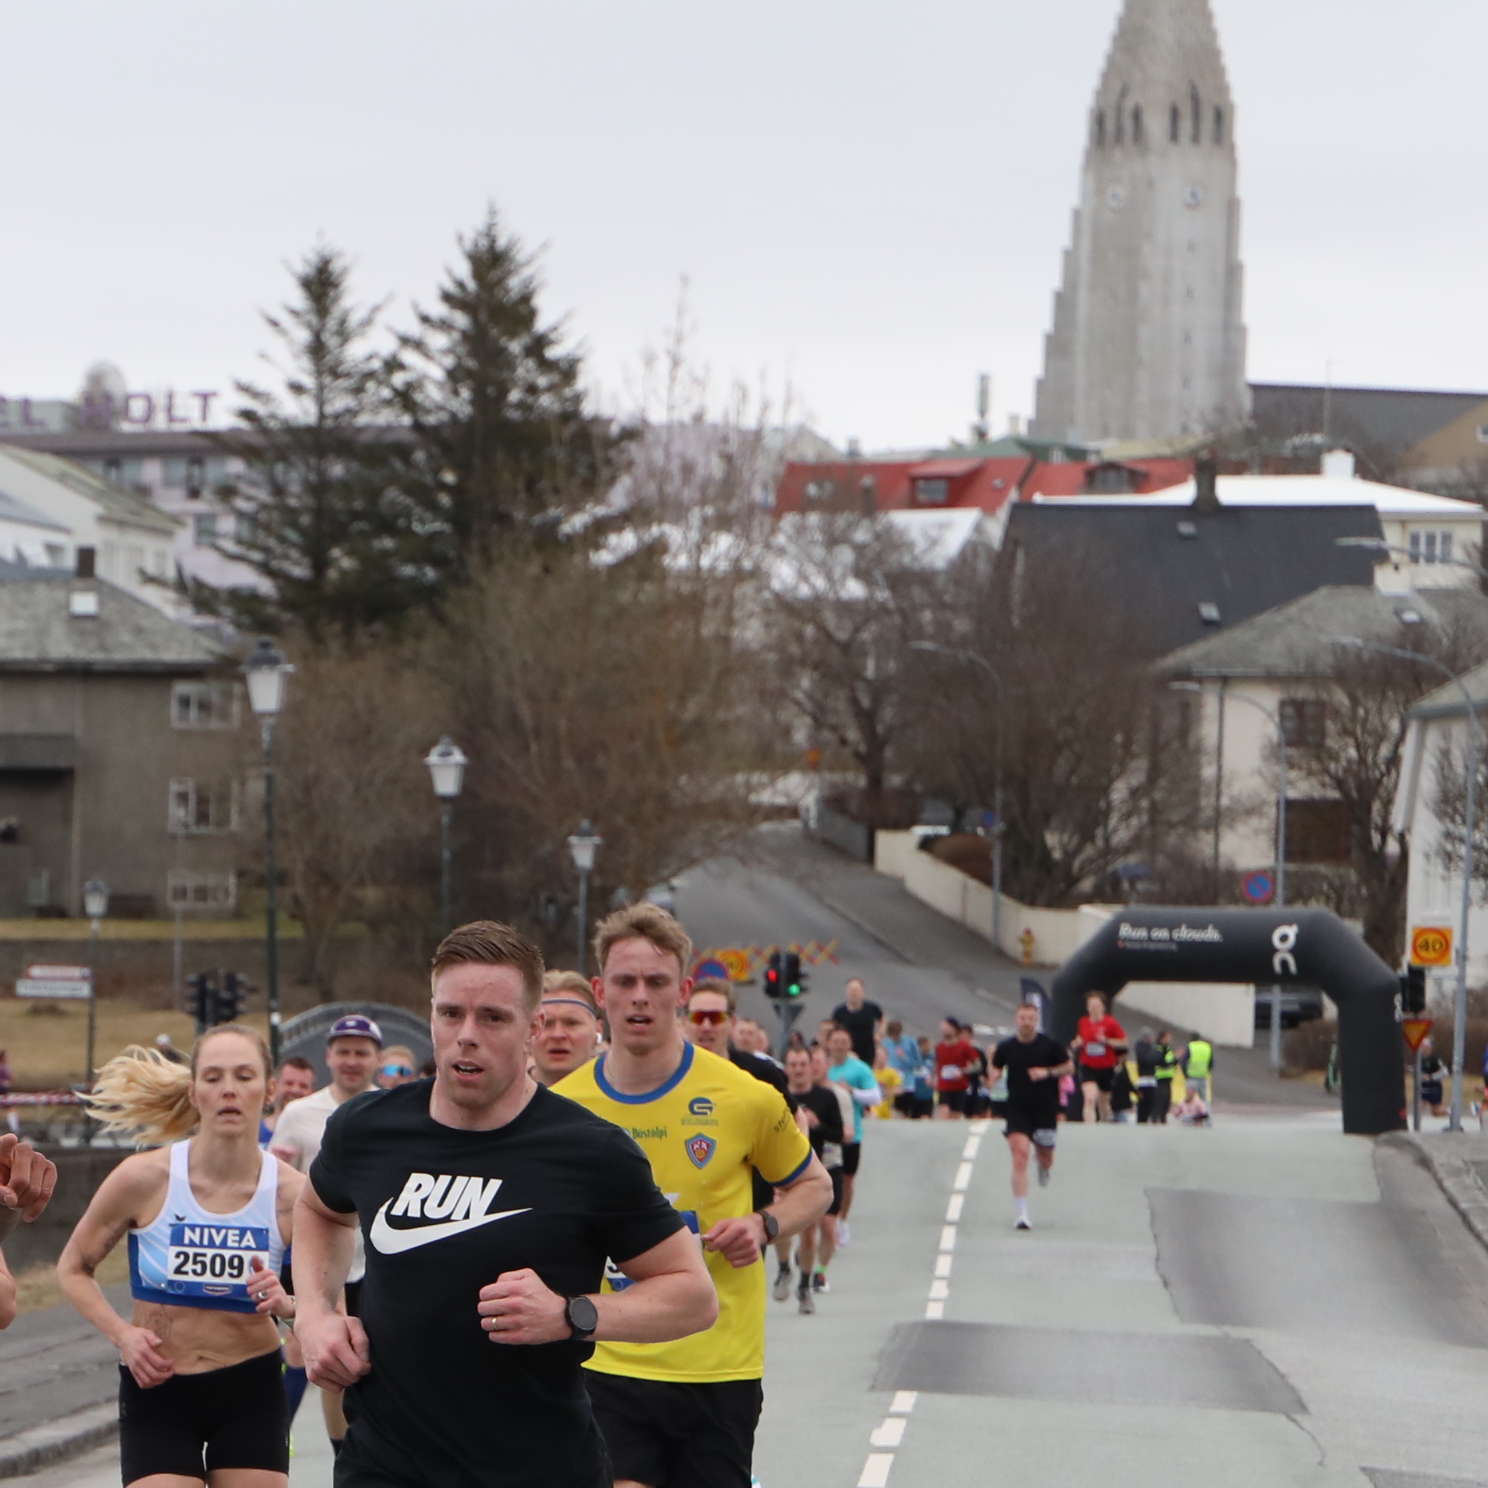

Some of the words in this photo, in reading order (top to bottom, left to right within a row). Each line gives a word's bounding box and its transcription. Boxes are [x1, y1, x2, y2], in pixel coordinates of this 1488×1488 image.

[80, 388, 220, 431] HOLT
[1418, 938, 1444, 953] 40
[390, 1172, 503, 1221] RUN
[183, 1226, 257, 1249] NIVEA
[173, 1251, 244, 1279] 2509
